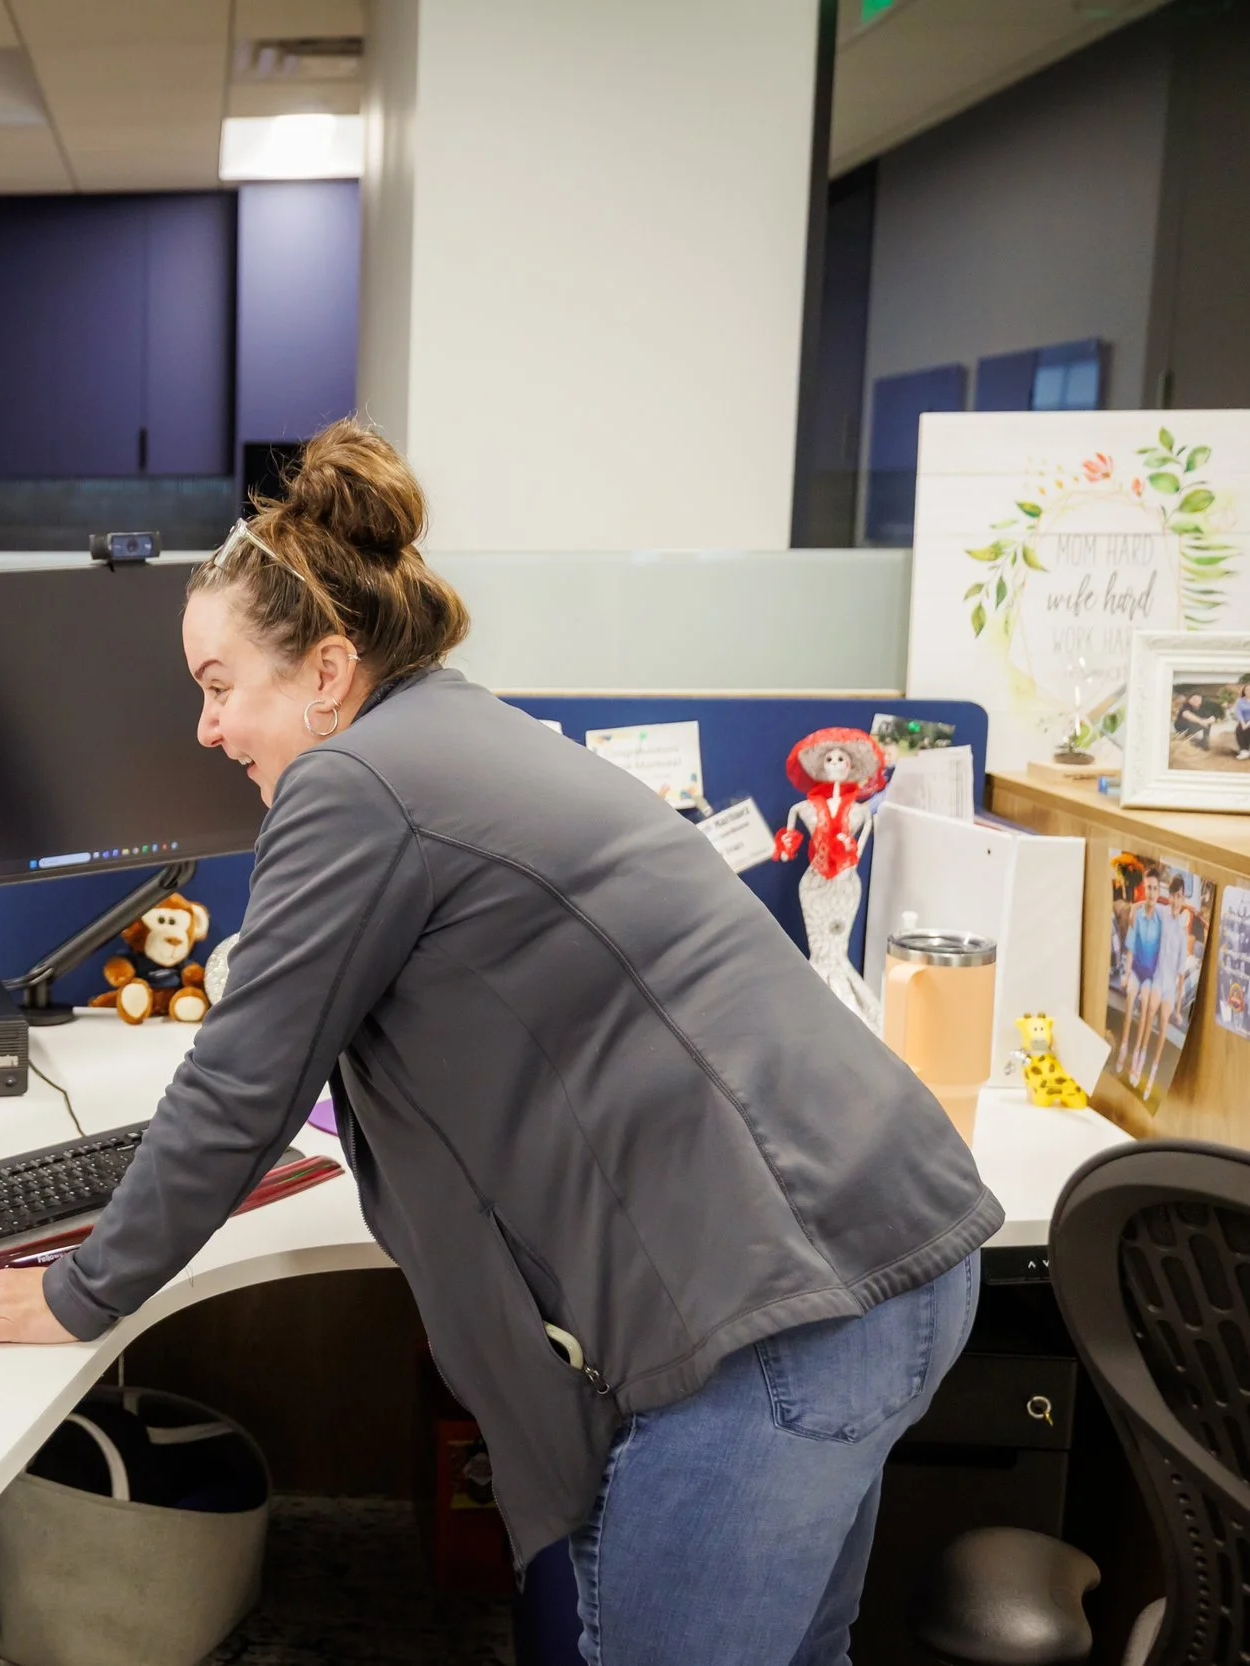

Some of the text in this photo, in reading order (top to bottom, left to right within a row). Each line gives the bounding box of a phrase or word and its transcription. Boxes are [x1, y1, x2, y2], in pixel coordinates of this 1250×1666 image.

[1056, 533, 1155, 566] MOM HARD
[1046, 568, 1158, 621] wife hard
[1052, 625, 1094, 655] WORK
